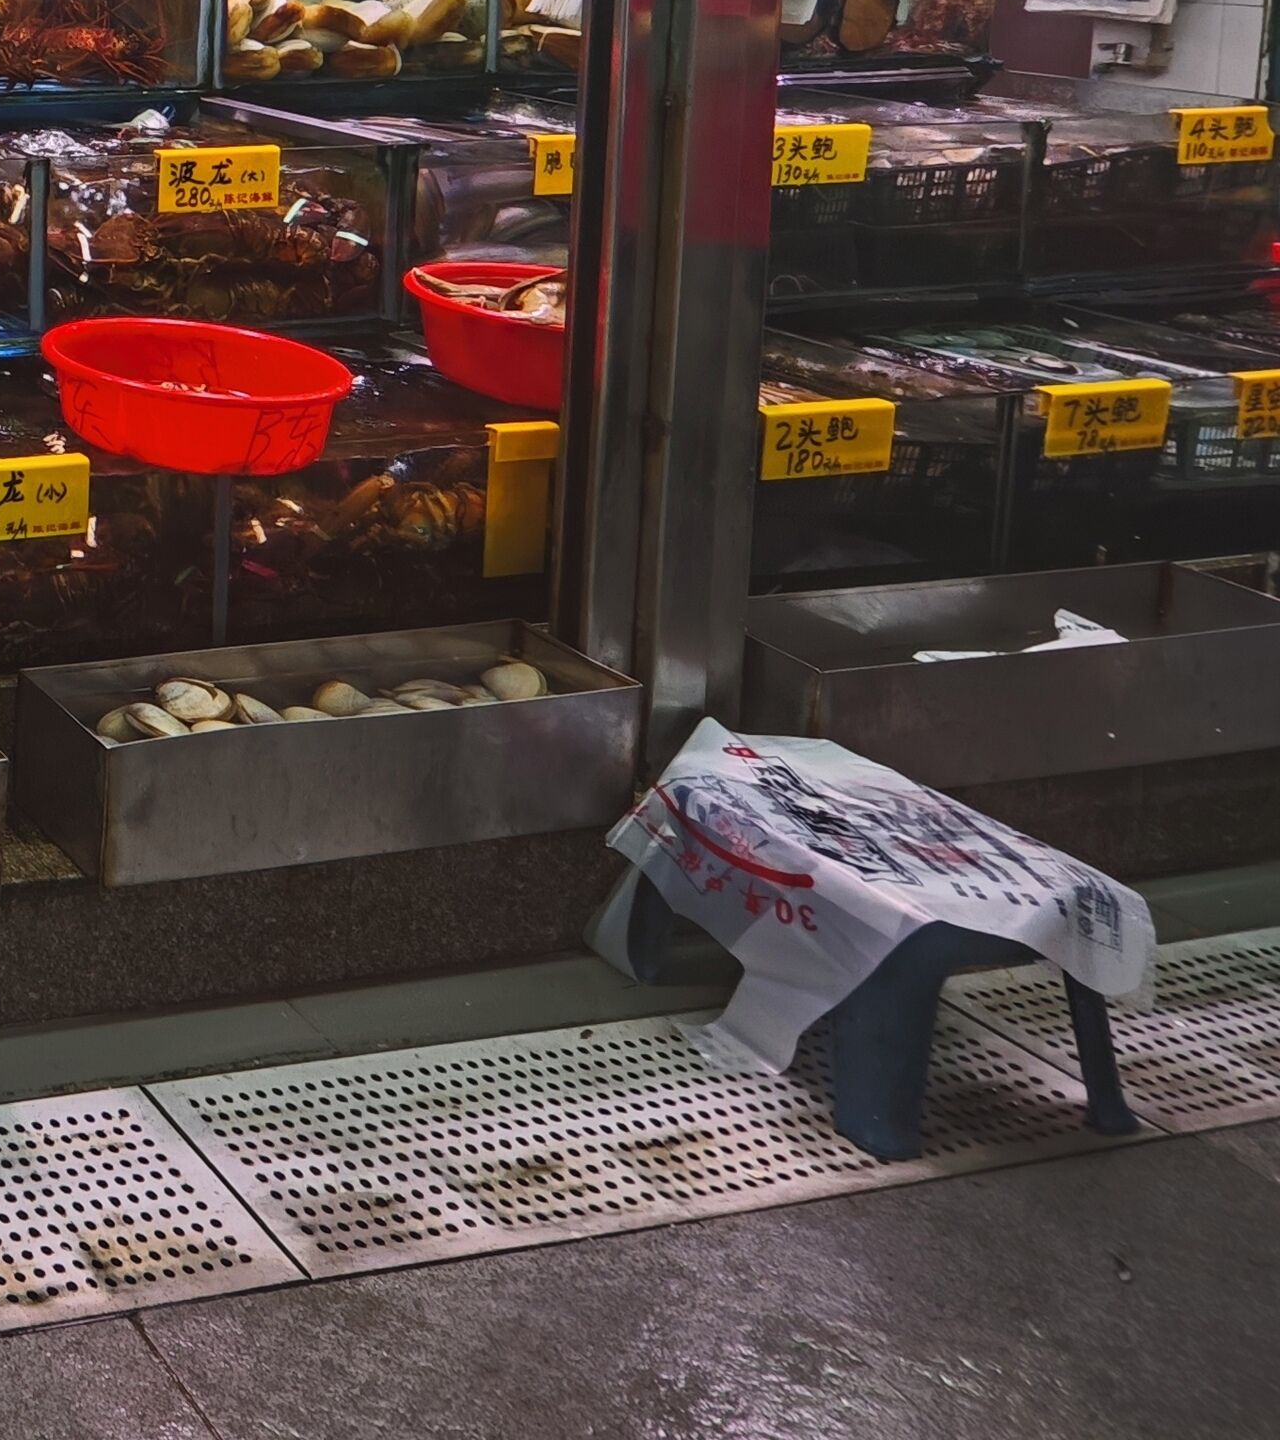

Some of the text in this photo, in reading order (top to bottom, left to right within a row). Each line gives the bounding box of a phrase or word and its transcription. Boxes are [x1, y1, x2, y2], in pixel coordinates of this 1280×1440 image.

[772, 136, 838, 162] 3头鲍
[224, 192, 273, 205] 陈记海鲜
[775, 416, 859, 451] 2头鲍
